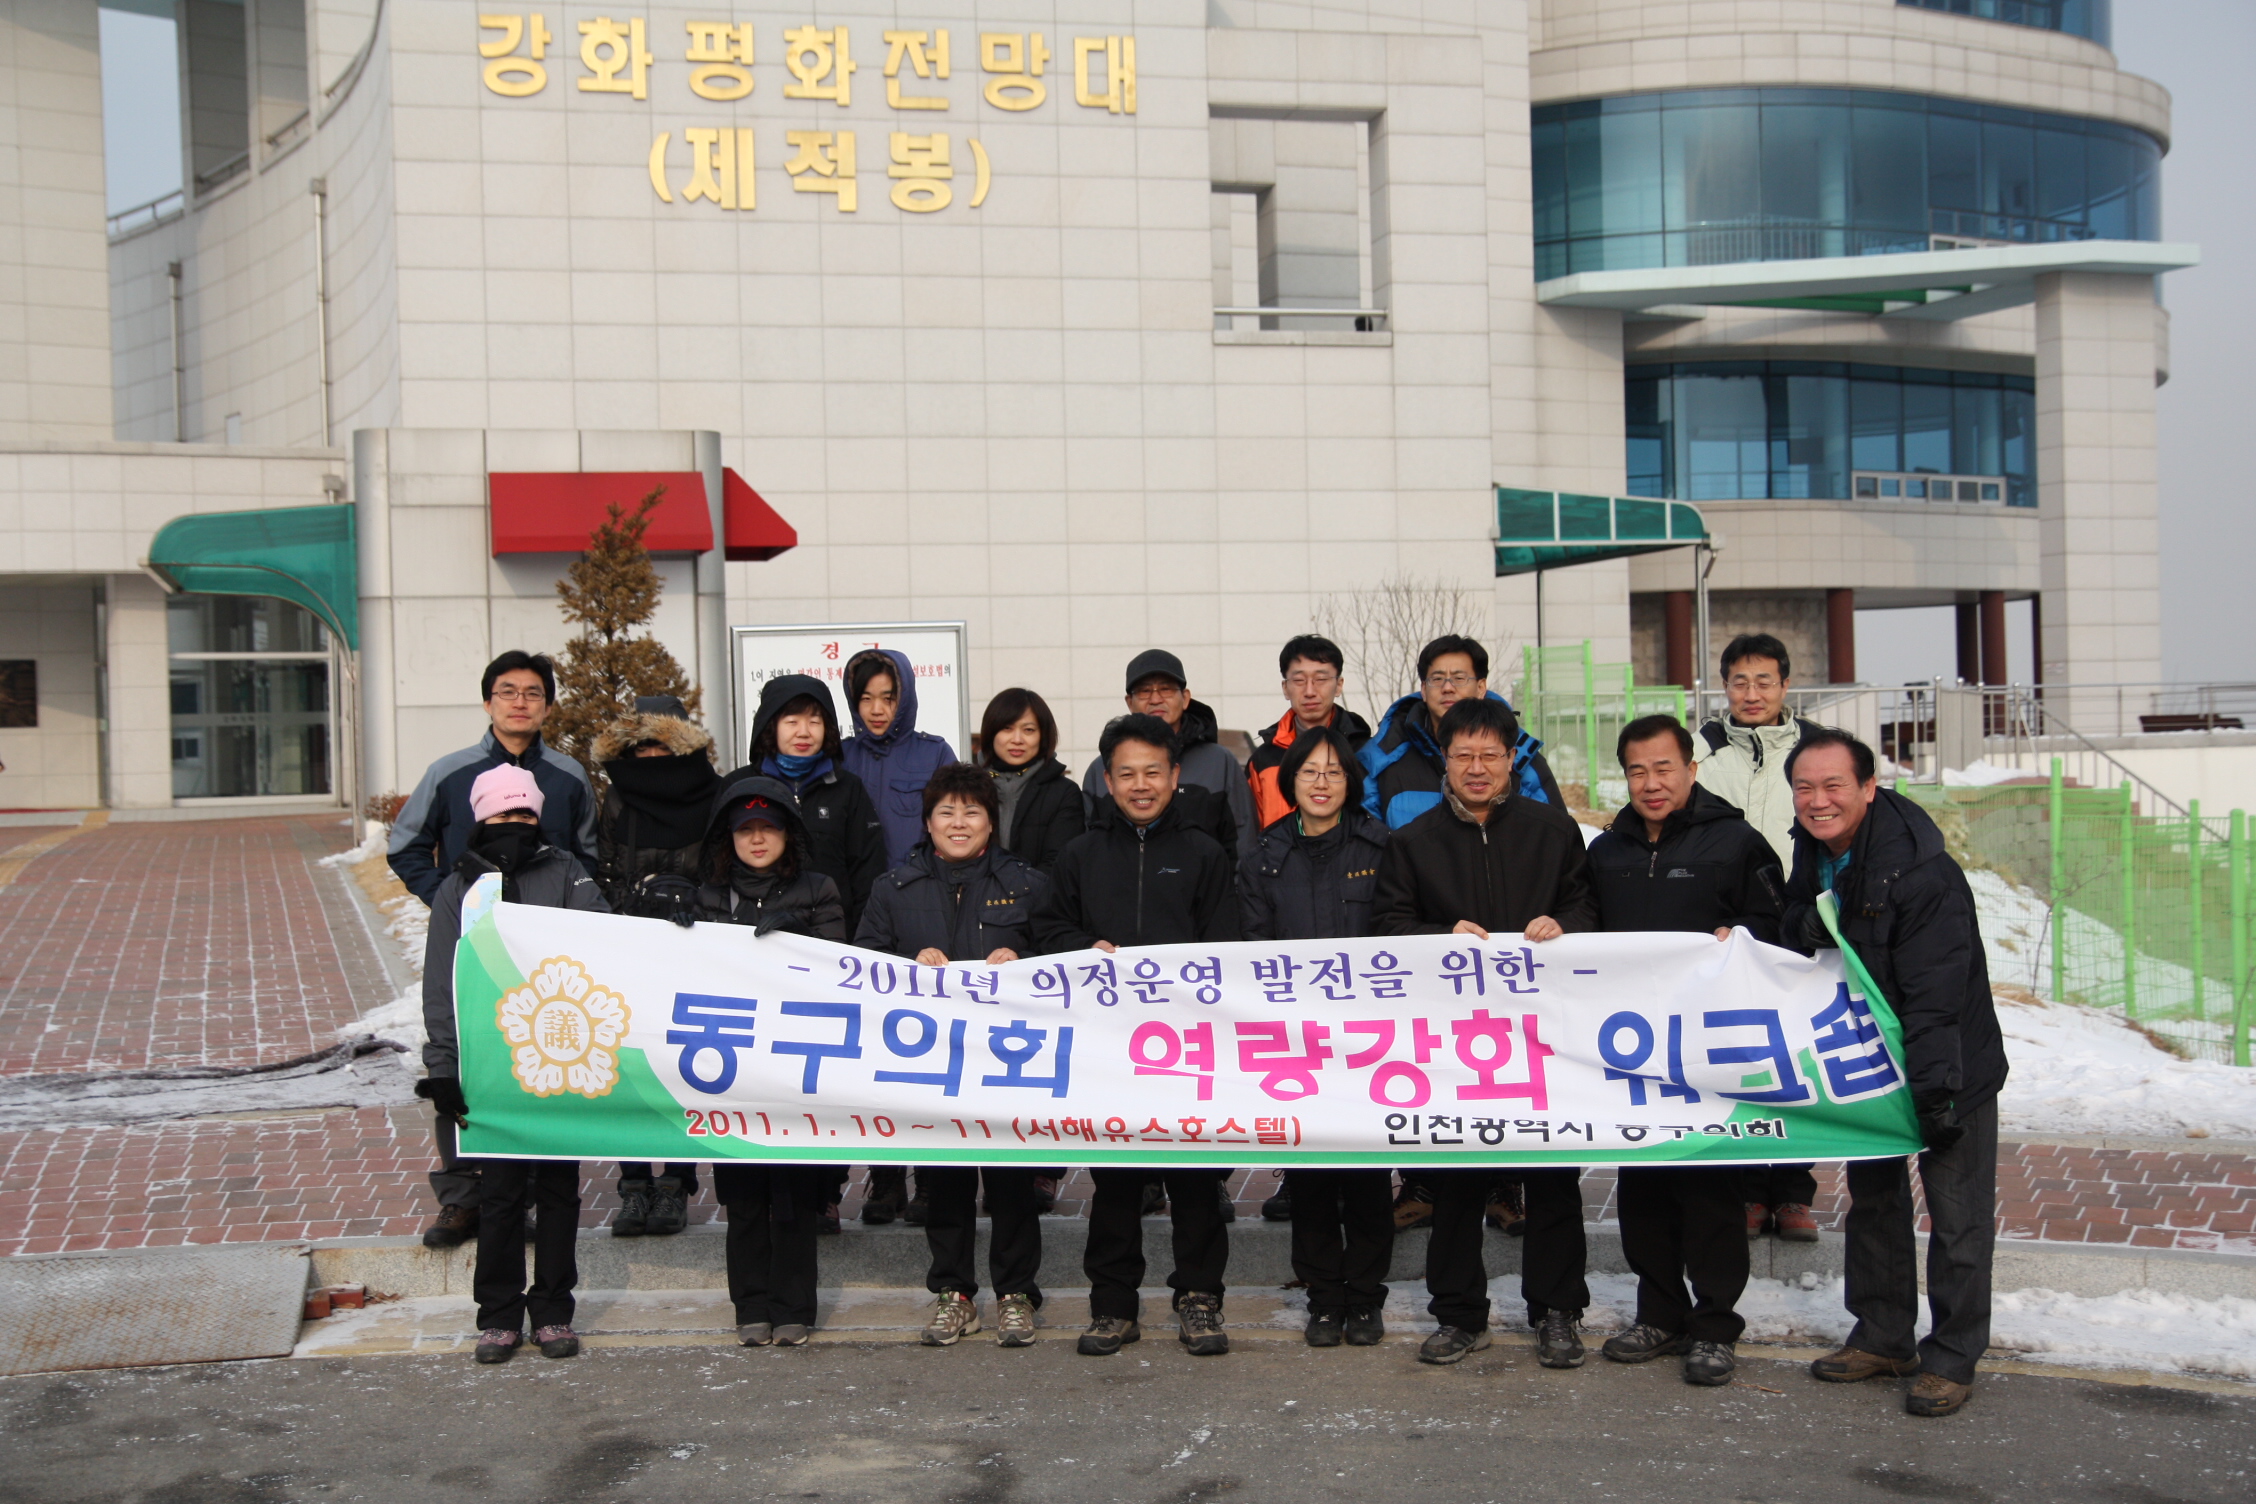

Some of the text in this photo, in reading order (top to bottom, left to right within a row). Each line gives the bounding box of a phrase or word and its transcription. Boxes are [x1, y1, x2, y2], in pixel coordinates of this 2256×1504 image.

[478, 13, 1137, 114] 강화평화전망대
[649, 127, 990, 213] (제적봉)
[838, 956, 1000, 1006] 2011년
[1031, 956, 1222, 1009] 의정운영
[1250, 950, 1413, 1003] 발전을
[1439, 946, 1545, 996] 위한
[543, 1009, 581, 1052] 議
[666, 982, 1900, 1111] 동구의회 역량강화 워크숍
[1012, 1115, 1301, 1147] (서해유스호스텔)
[1384, 1112, 1594, 1146] 인천광역시
